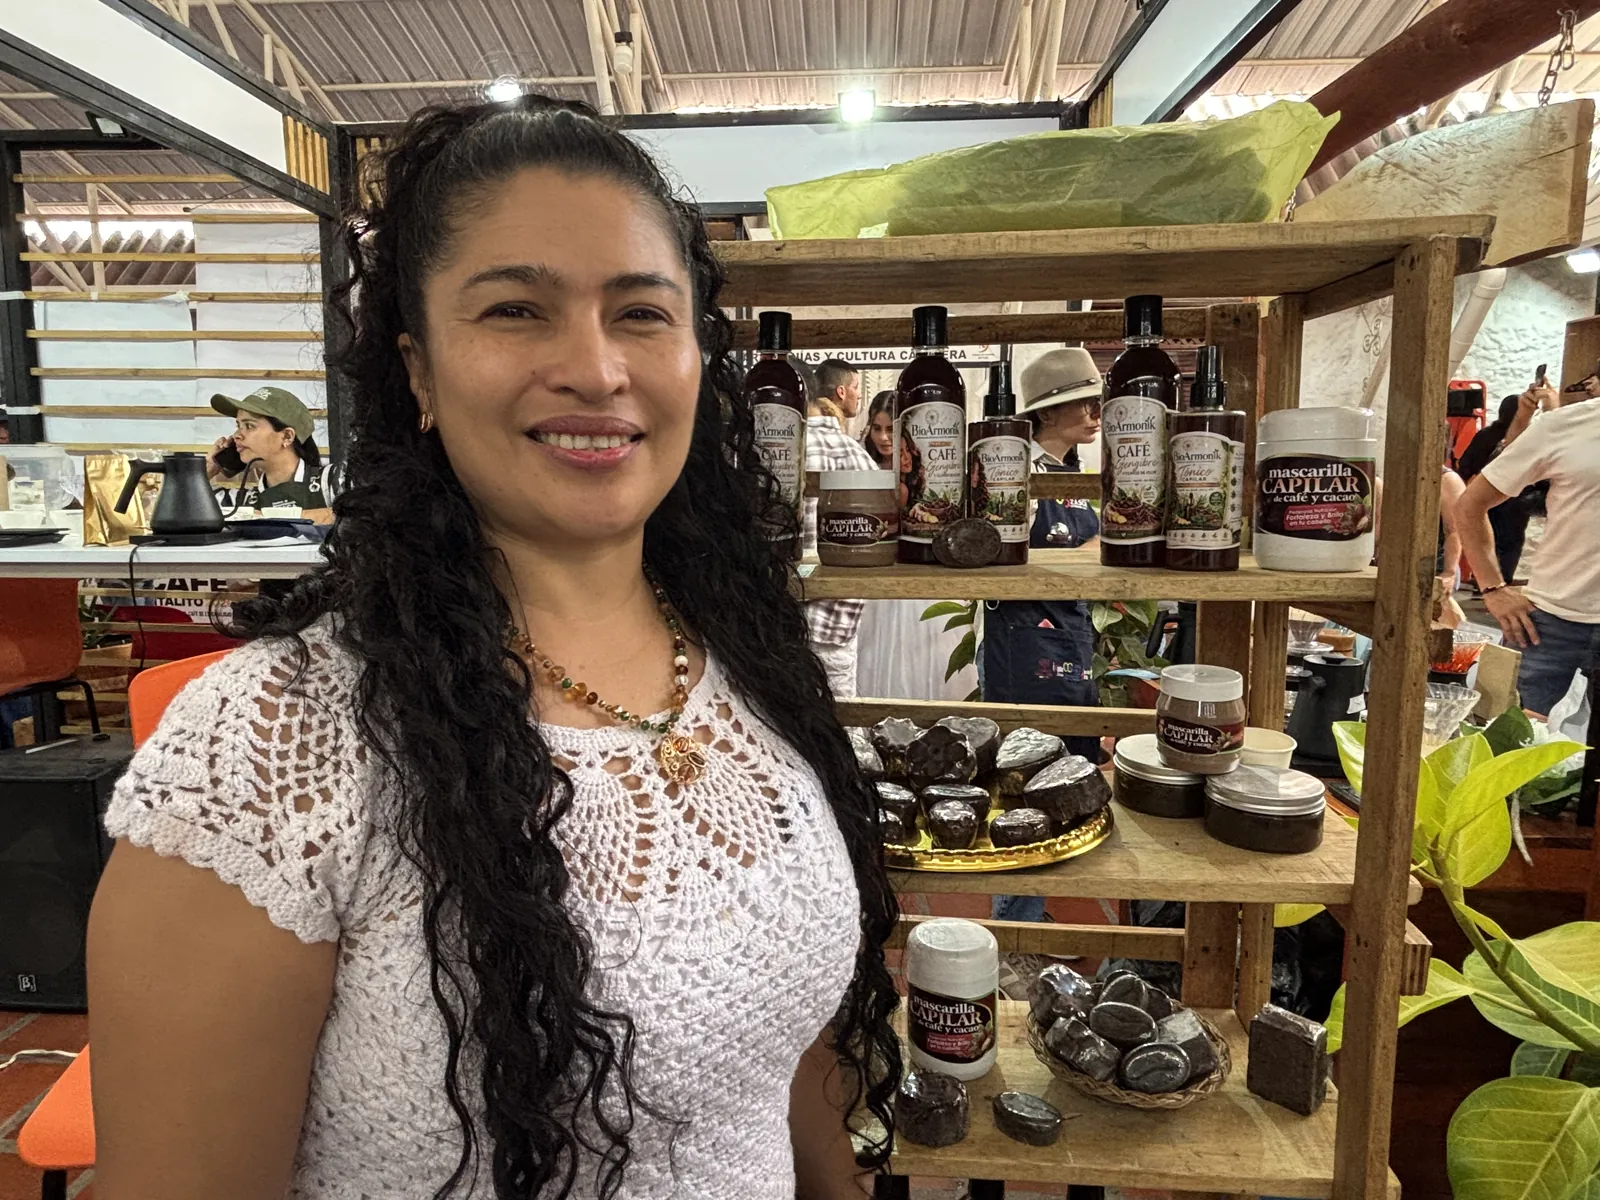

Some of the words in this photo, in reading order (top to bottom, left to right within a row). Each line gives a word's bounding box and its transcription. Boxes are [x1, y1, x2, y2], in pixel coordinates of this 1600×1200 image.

[824, 352, 833, 360] Y
[836, 350, 896, 361] CULTURA
[899, 349, 967, 360] CAERA
[756, 425, 795, 436] oArmonik
[762, 447, 791, 460] CAFÉ
[928, 446, 956, 460] CAFÉ
[1117, 442, 1150, 458] CAFÉ
[1269, 464, 1352, 477] mascarilla
[1262, 478, 1360, 494] CAPILAR
[1283, 492, 1309, 503] café
[1311, 496, 1320, 505] y
[1322, 494, 1356, 503] cacao
[829, 516, 869, 527] mascarilla
[1286, 513, 1320, 521] Fortaleza
[825, 523, 873, 533] CAPILAR
[154, 598, 204, 607] ITALITO
[1164, 728, 1213, 743] CAPILAR
[1168, 724, 1208, 735] mascarilla
[914, 996, 975, 1014] mascarilla
[910, 1001, 982, 1027] CAPILAR
[925, 1021, 943, 1031] café
[944, 1027, 952, 1035] y
[953, 1025, 980, 1034] cacao
